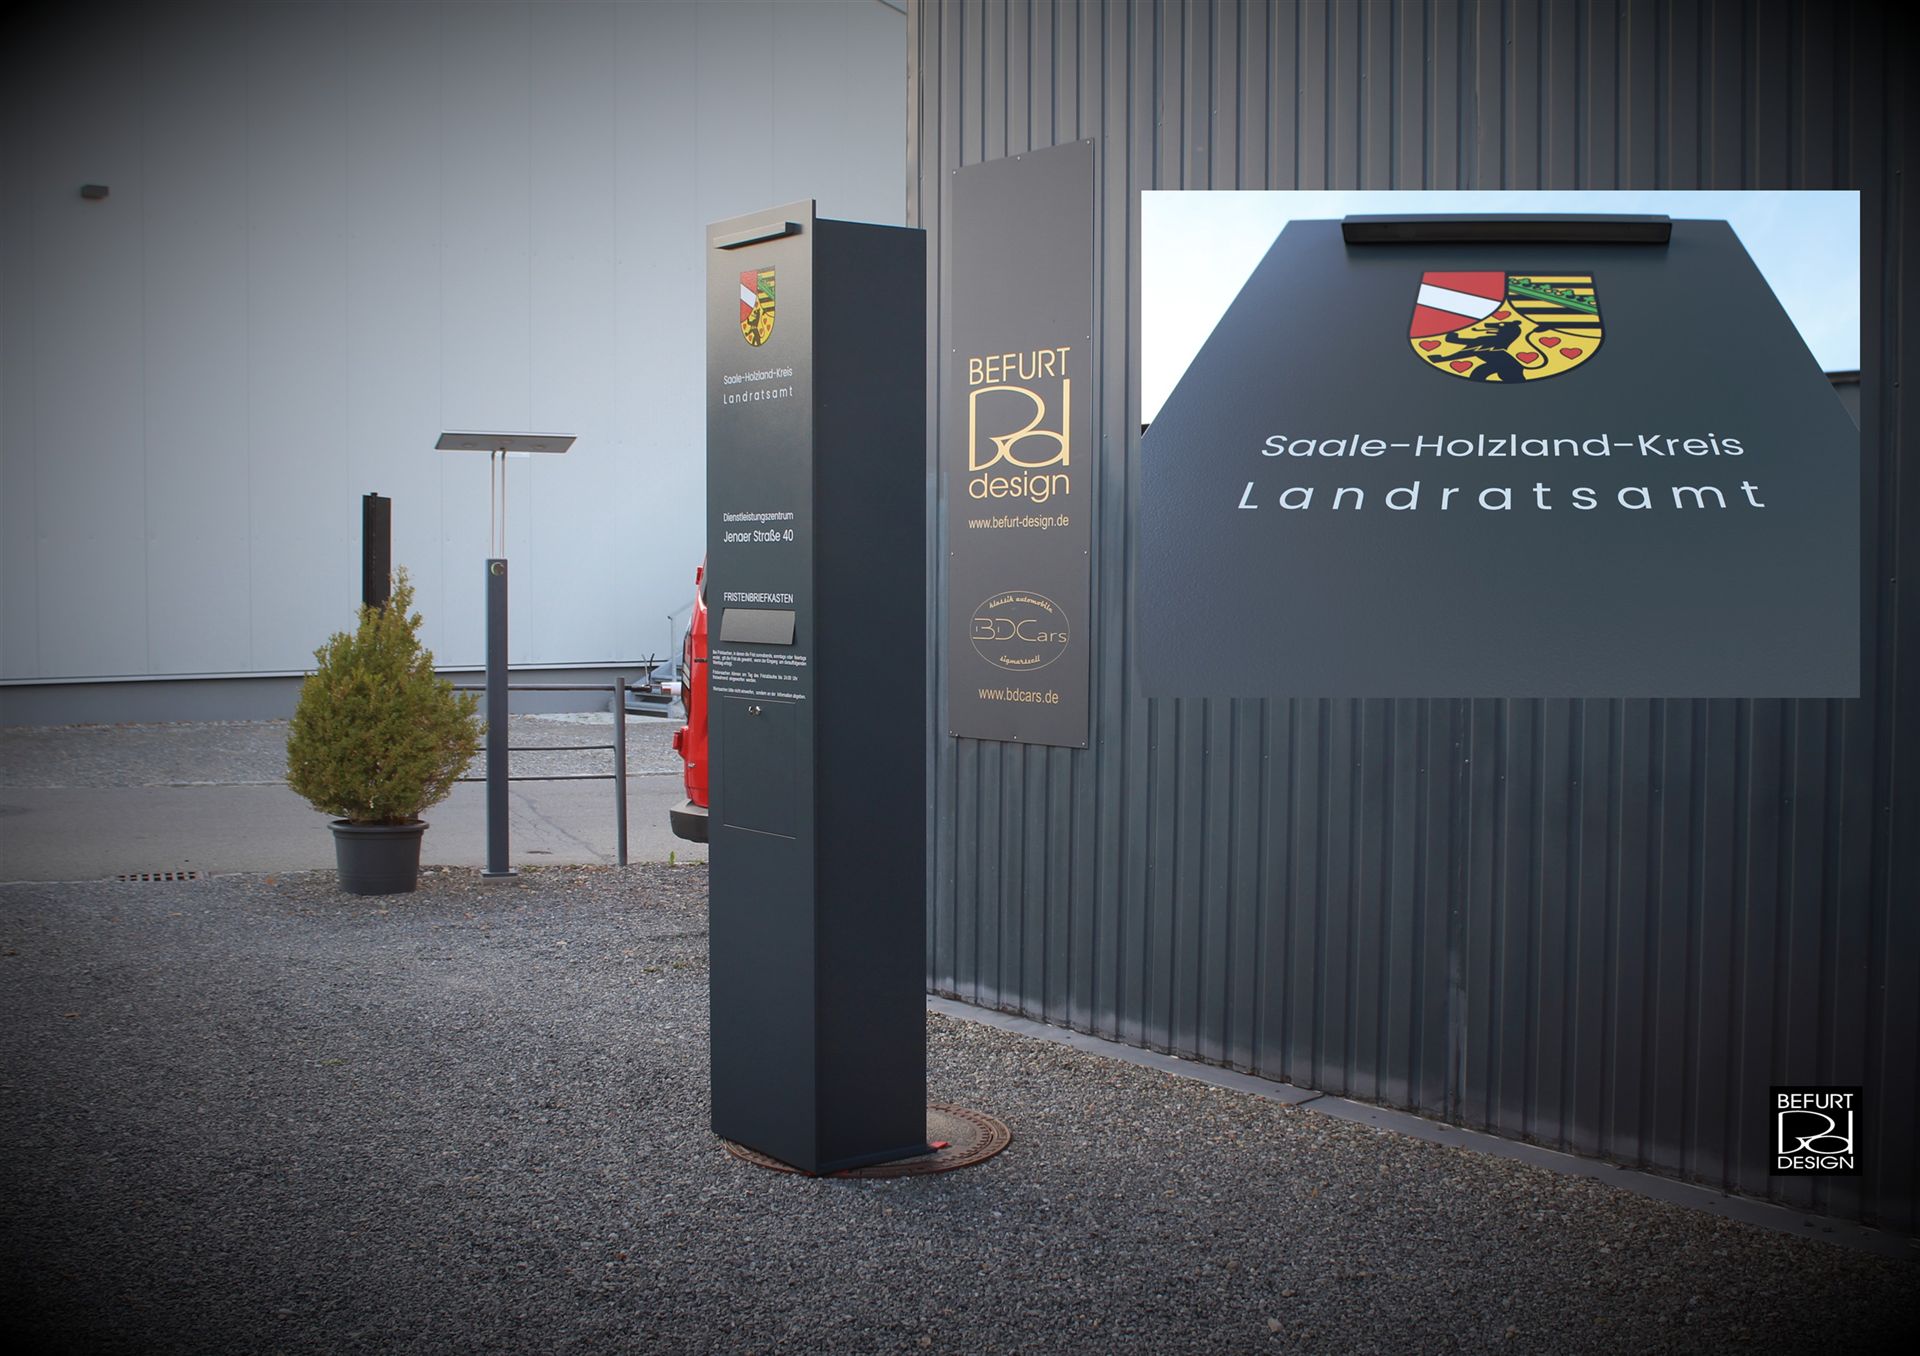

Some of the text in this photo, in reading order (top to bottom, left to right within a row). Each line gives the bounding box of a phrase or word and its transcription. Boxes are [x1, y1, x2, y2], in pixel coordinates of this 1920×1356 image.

[723, 366, 793, 385] Saale-Holzland-Kreis
[968, 346, 1071, 386] BEFURT
[723, 385, 793, 405] Landratsamt
[1261, 432, 1745, 458] Saale-Holzland-Kreis
[968, 470, 1070, 504] design
[1237, 479, 1766, 511] Landratsamt
[723, 511, 794, 524] Dienstleistungszentrum
[968, 514, 1070, 530] www.befurt-design.de
[723, 529, 794, 543] Jenaer Straße 40
[723, 592, 794, 604] FRISTENBRIEFKASTEN
[972, 617, 1068, 643] BDCars
[978, 687, 1059, 705] www.bdcars.de
